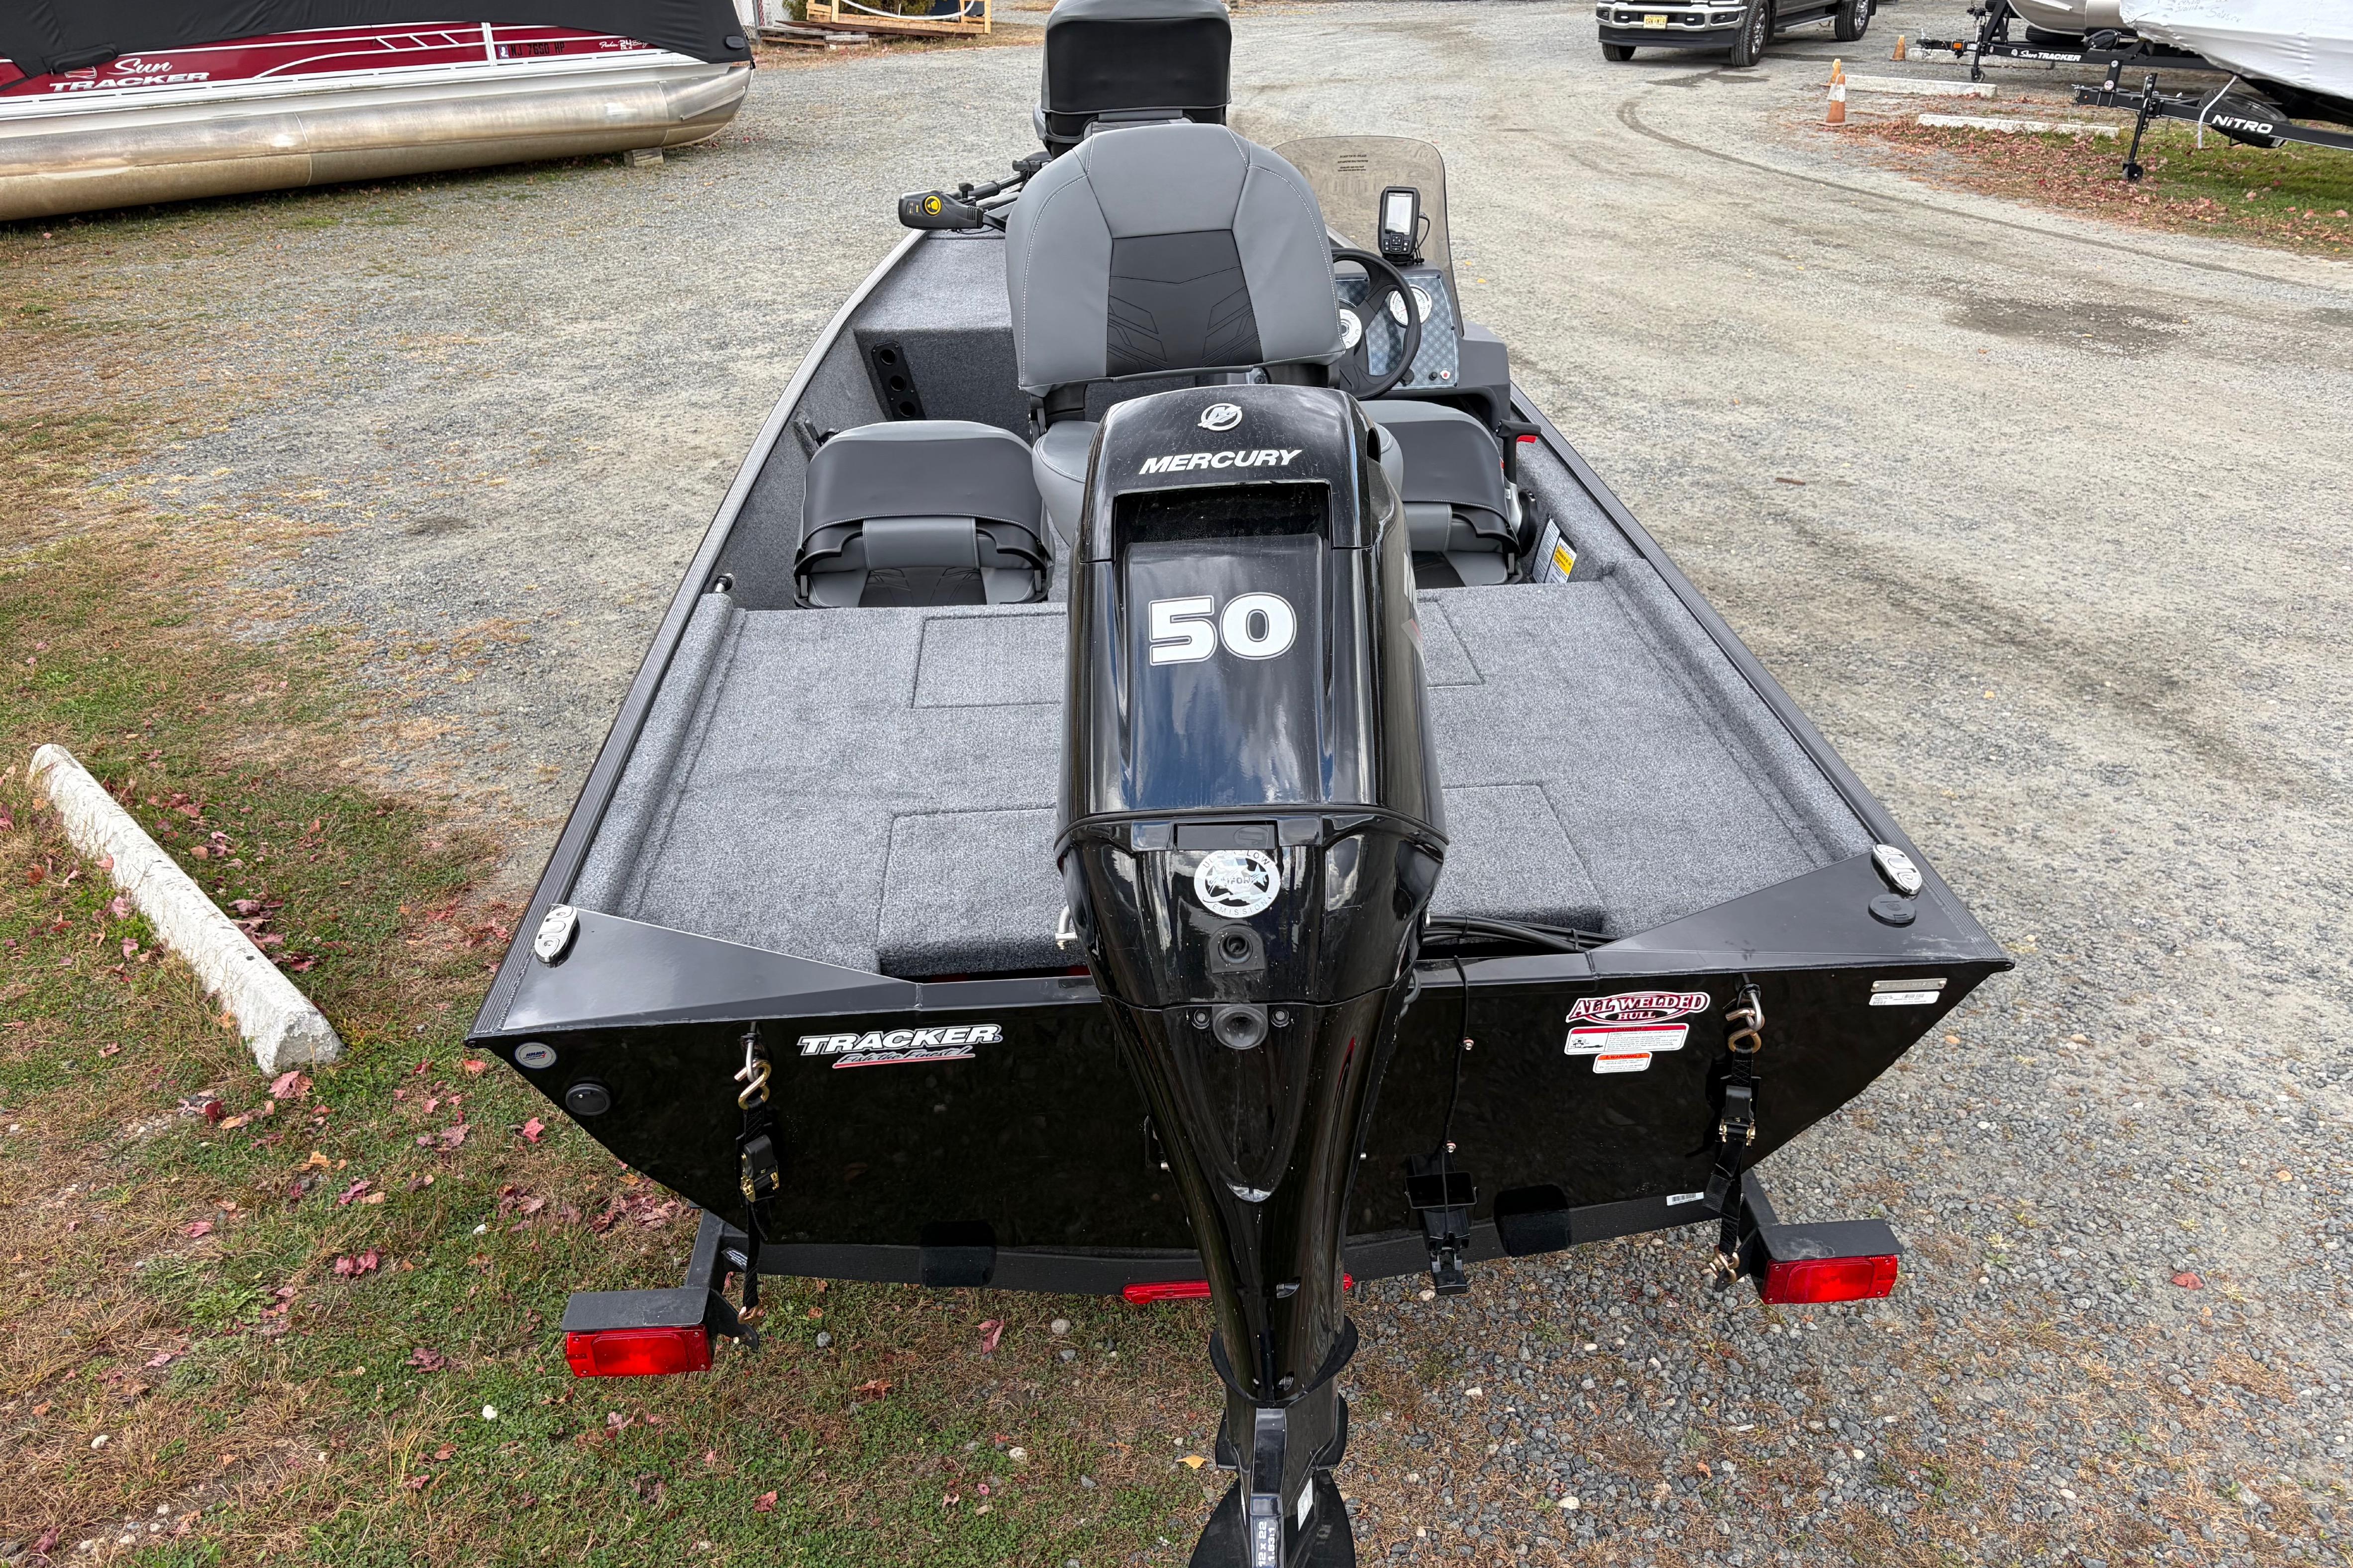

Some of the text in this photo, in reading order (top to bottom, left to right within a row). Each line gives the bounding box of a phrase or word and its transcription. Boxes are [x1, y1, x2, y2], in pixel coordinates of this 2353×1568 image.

[510, 44, 522, 56] NJ
[554, 41, 565, 54] HP
[2038, 52, 2081, 62] TRACKER
[106, 58, 173, 75] Sun
[49, 72, 209, 93] TRACKER
[1138, 449, 1302, 475] MERCURY
[1148, 591, 1297, 666] 50
[1246, 850, 1270, 866] LOW
[1569, 994, 1708, 1018] ALL WELDED
[1617, 1011, 1656, 1020] HULL
[800, 1024, 999, 1055] TRACKER
[839, 1054, 874, 1064] Fish
[877, 1051, 904, 1061] the
[1258, 1521, 1267, 1539] 22
[1258, 1552, 1266, 1568] 12
